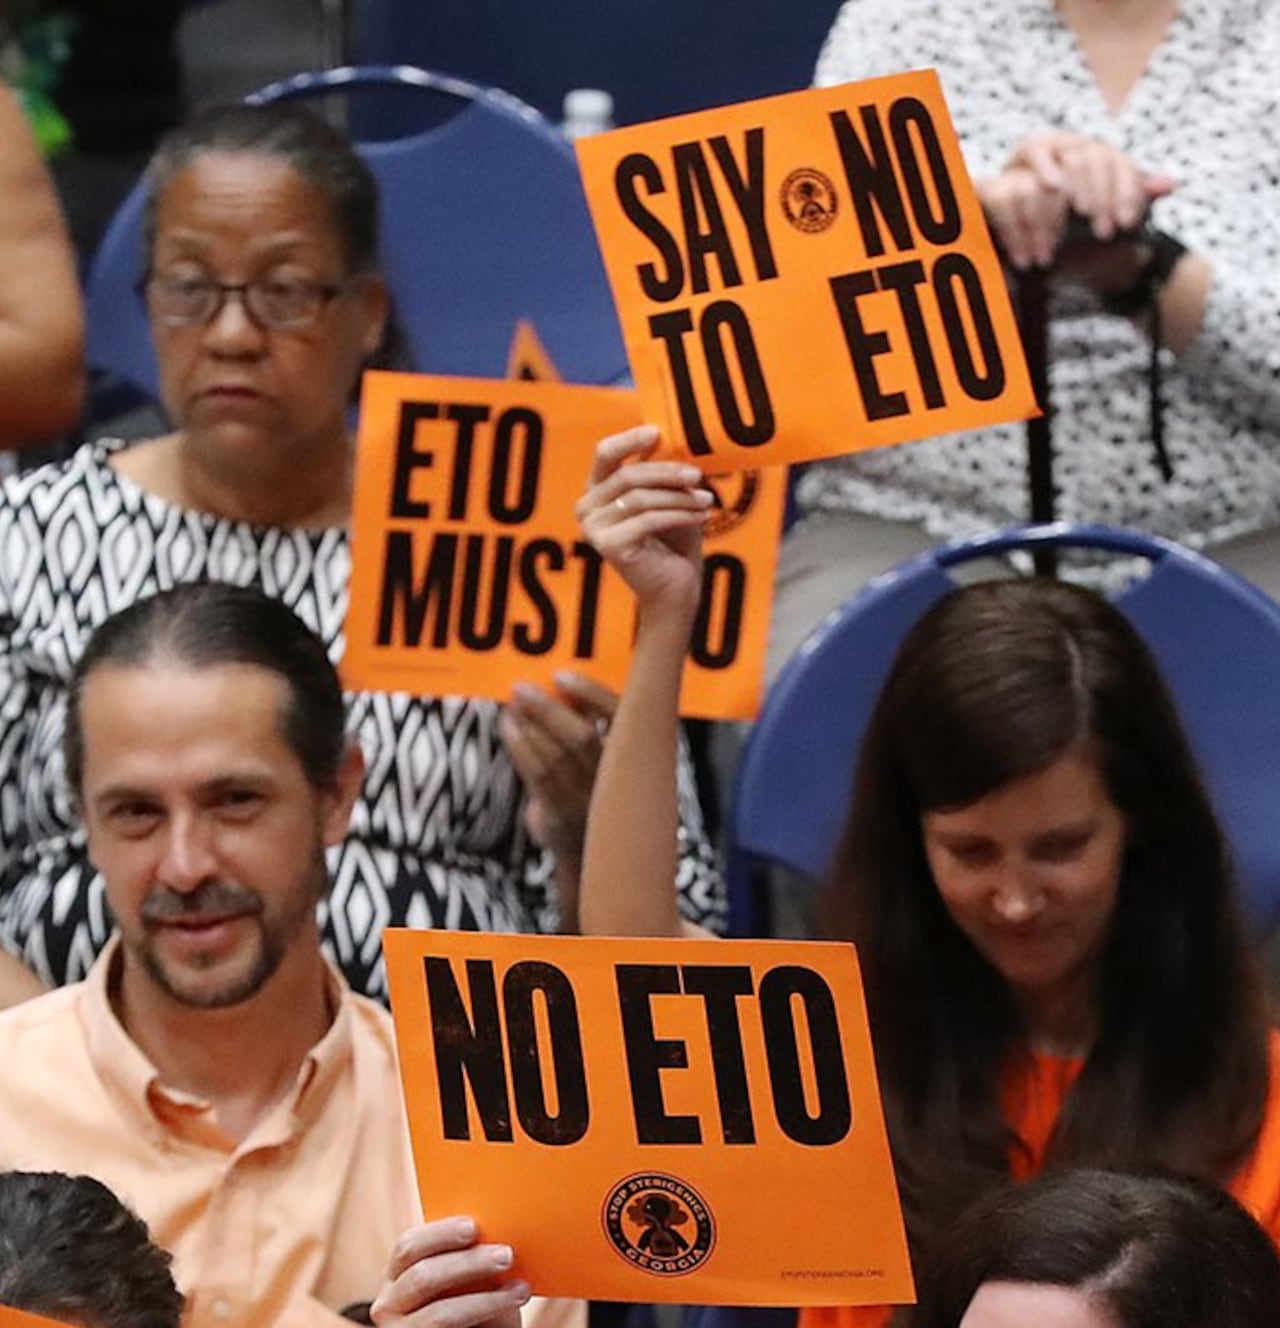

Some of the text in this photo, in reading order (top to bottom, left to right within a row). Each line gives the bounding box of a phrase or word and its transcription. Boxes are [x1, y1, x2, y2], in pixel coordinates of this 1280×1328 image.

[614, 98, 961, 302] SAY NO
[648, 301, 775, 456] TO
[830, 253, 1005, 421] ETO
[389, 402, 543, 524] ETO
[377, 531, 604, 658] MUST
[424, 957, 851, 1146] NO ETO
[609, 1179, 706, 1221] STOP STERIGENICS
[626, 1248, 705, 1271] GEORGIA
